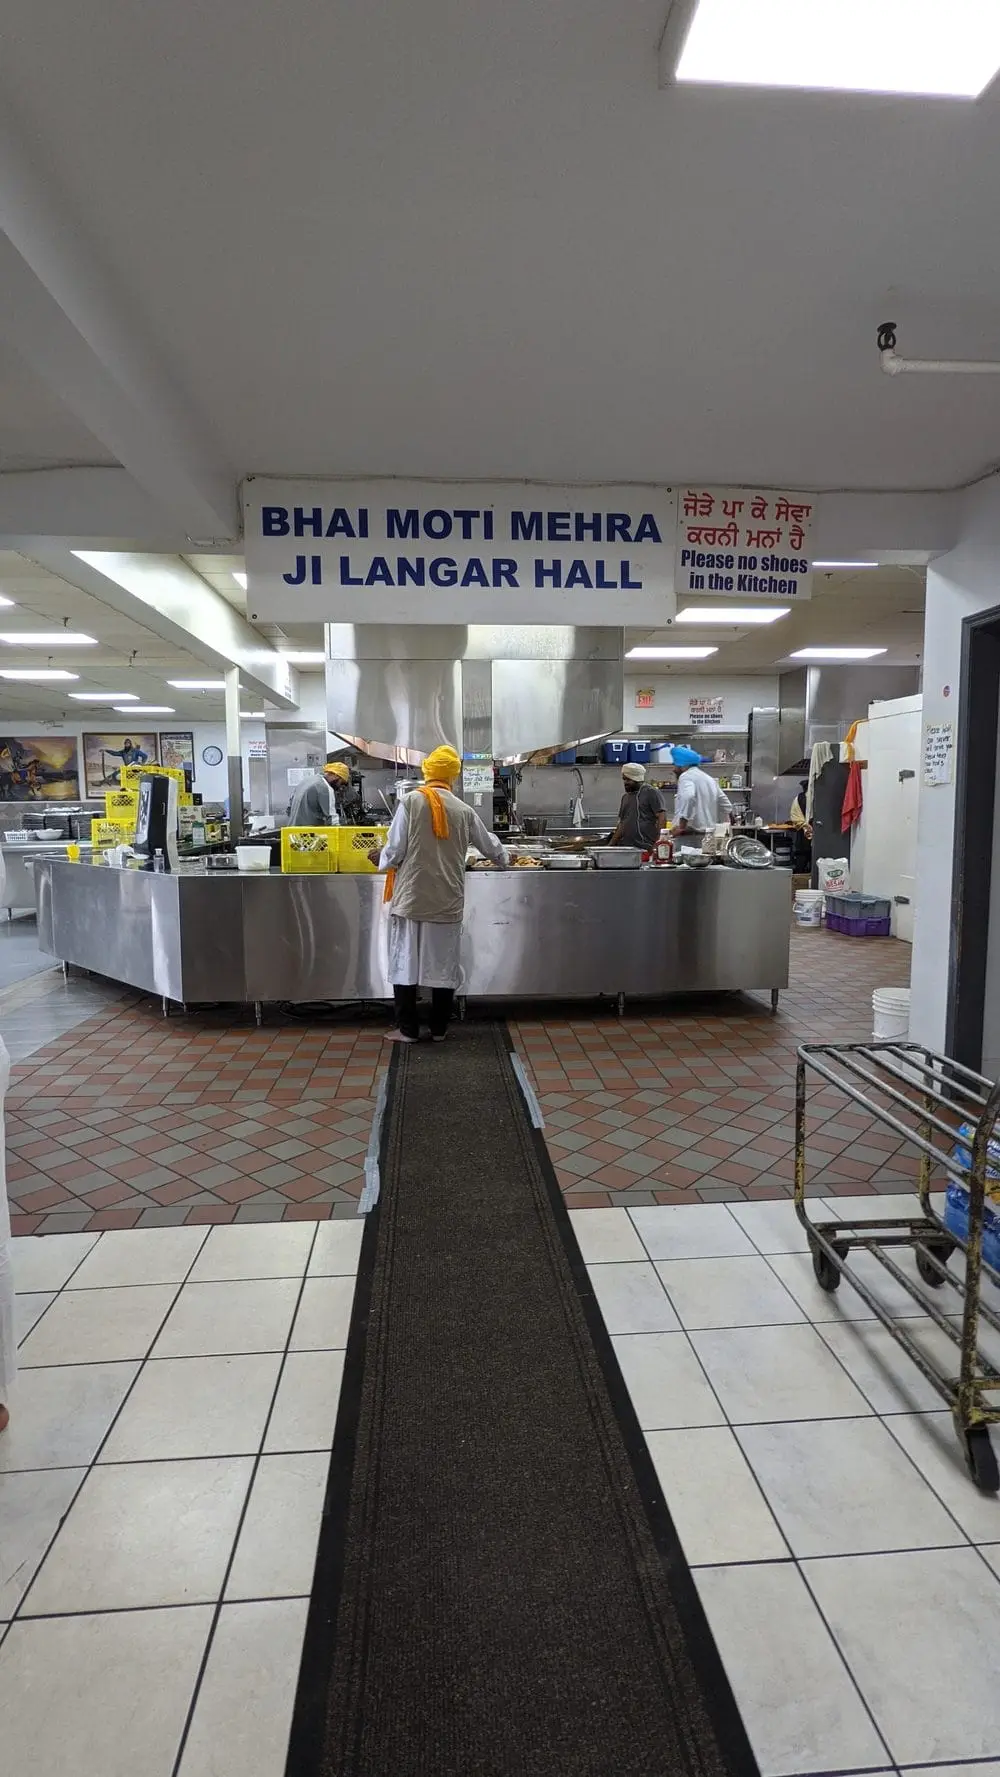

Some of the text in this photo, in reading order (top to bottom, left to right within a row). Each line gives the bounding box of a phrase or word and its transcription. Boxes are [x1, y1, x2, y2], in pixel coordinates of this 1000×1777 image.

[683, 490, 812, 523] ਜੋੜੇ ਪਾ ਕੇ ਸੇਵਾ
[261, 506, 662, 544] BHAI MOTI MEHRA
[687, 522, 805, 551] ਕਰਨੀ ਮਨਾਂ ਹੈ
[282, 555, 643, 590] JI LANGAR HALL
[681, 549, 808, 574] Please no shoes
[689, 572, 797, 595] in the Kitchen
